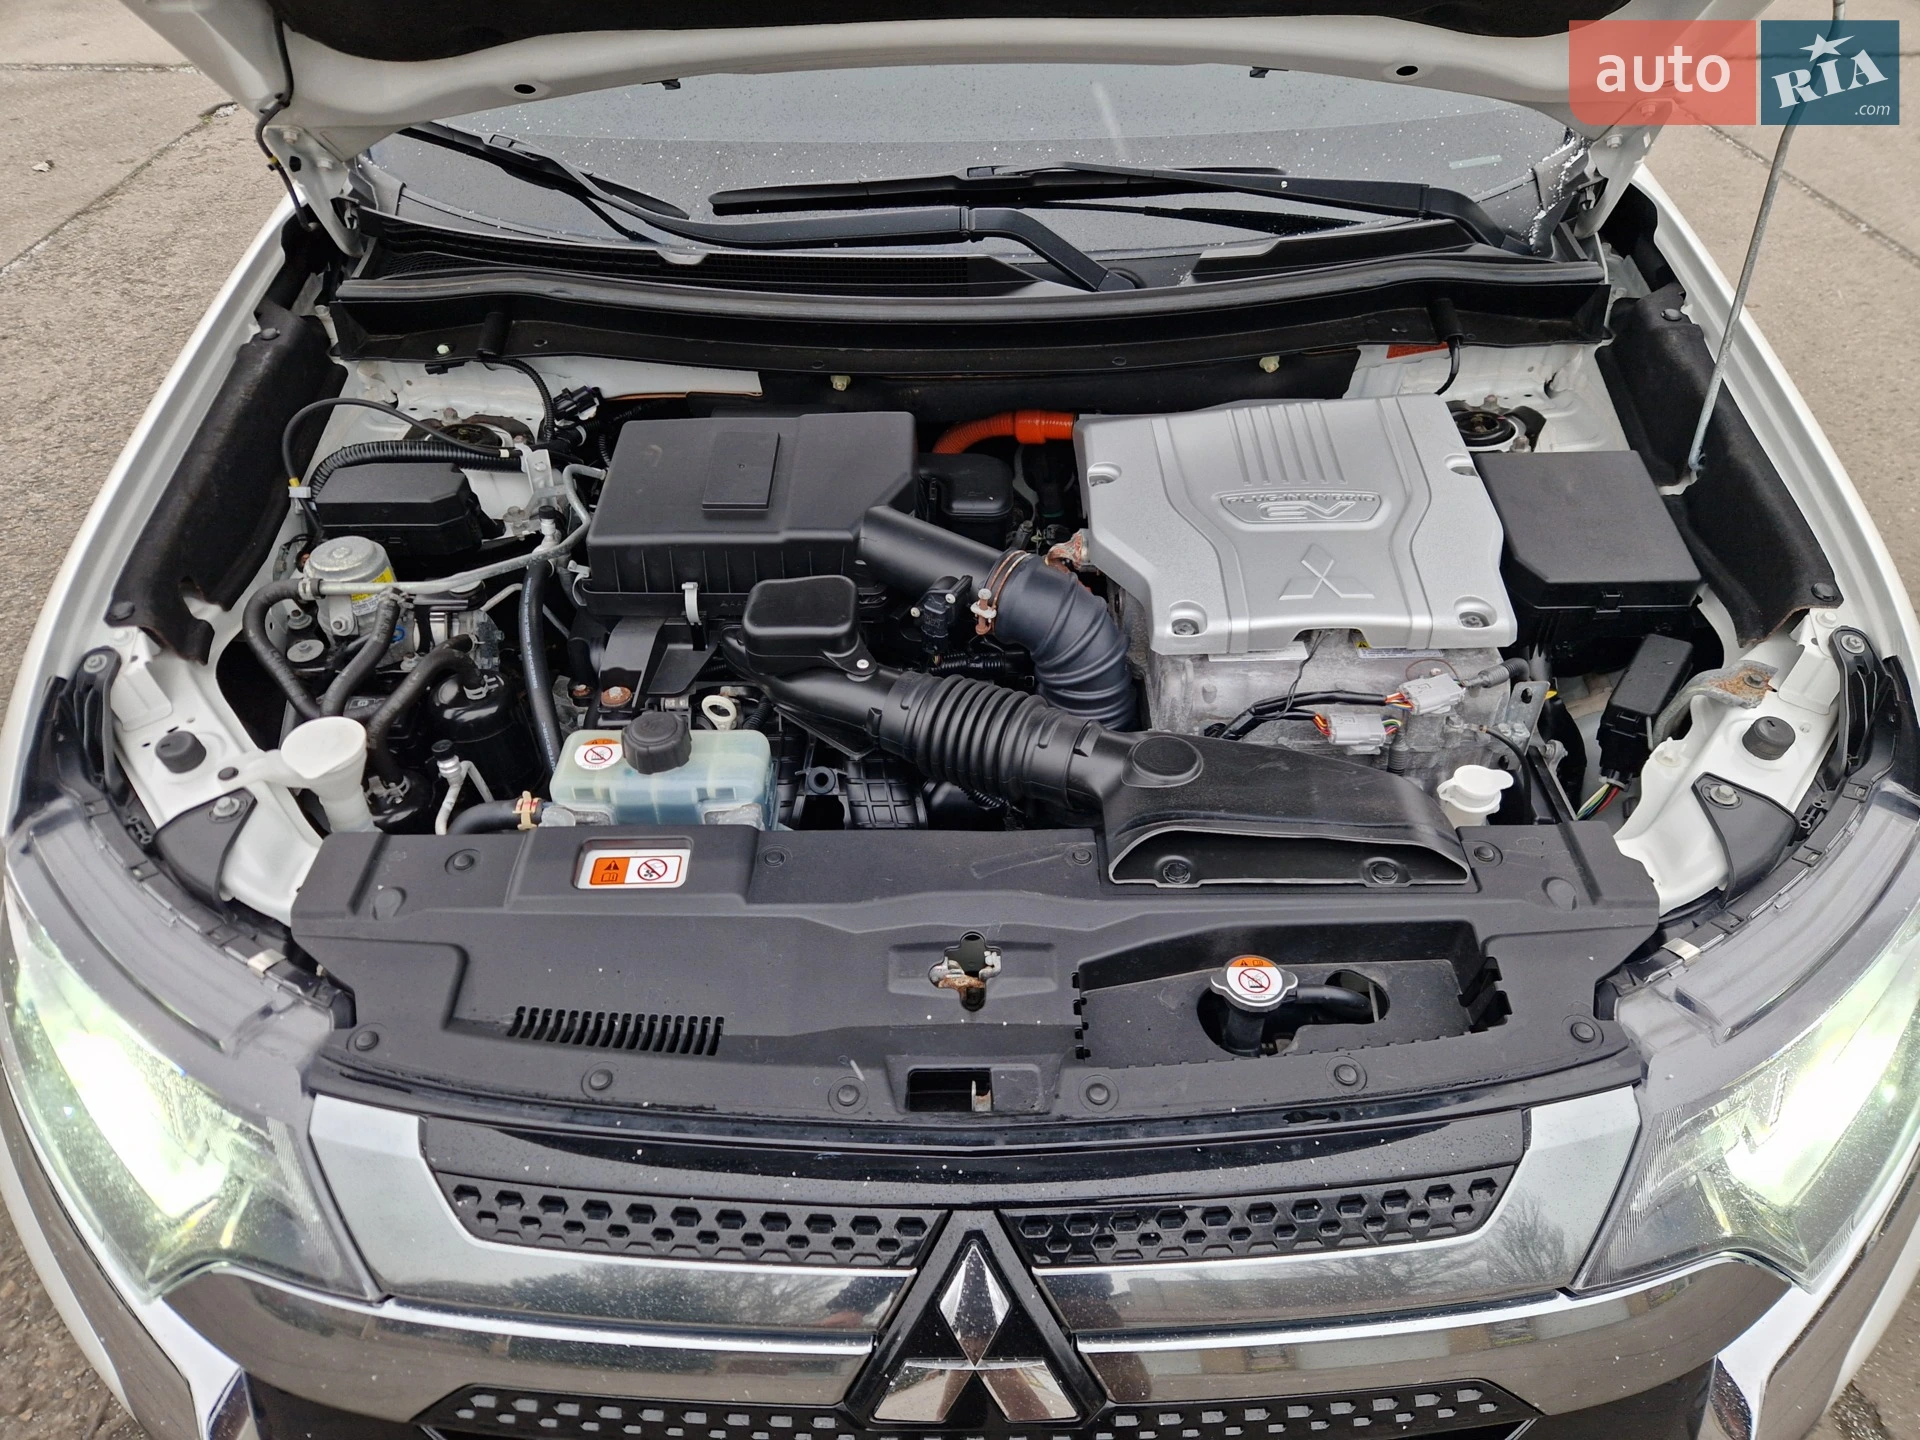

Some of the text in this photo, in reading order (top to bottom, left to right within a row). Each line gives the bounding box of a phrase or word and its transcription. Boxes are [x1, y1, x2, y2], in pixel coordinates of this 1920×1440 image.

[1226, 493, 1376, 504] PLUG-IN HYBRID
[1257, 501, 1357, 520] EV
